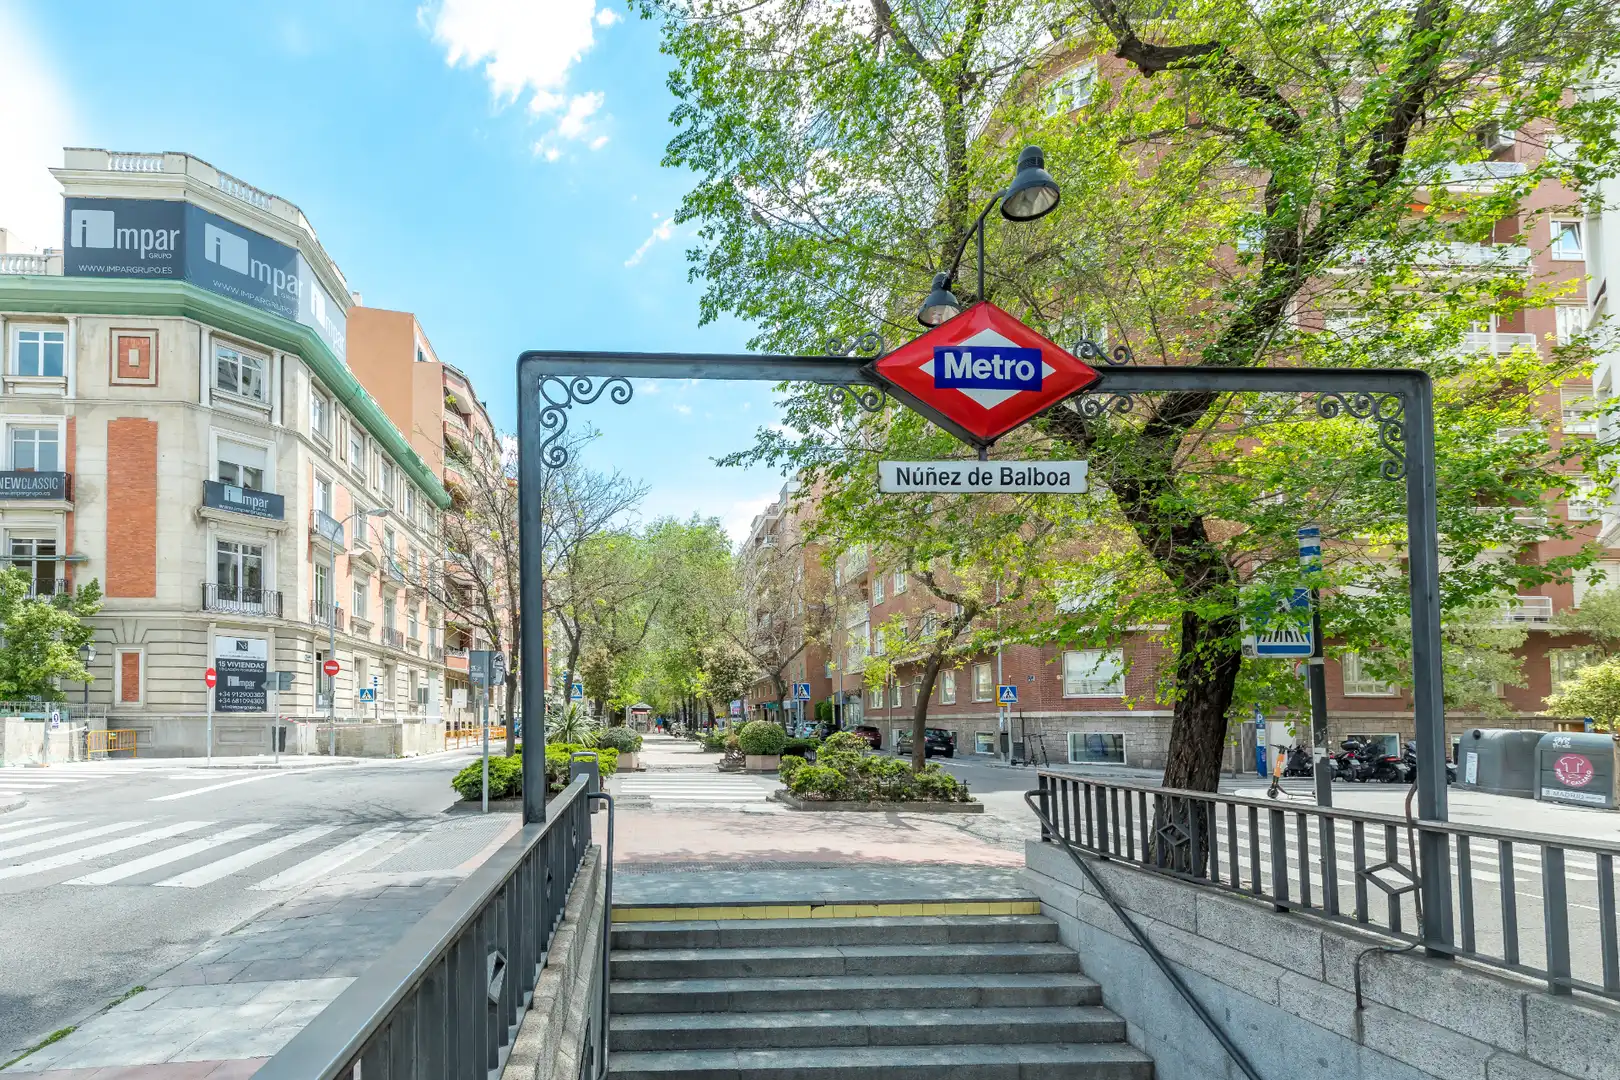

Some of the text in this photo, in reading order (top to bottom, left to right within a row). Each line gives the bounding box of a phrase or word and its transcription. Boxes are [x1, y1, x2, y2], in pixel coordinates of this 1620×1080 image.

[78, 264, 173, 275] WWW.IMPARGRUPO.ES
[944, 352, 1035, 381] Metro
[896, 467, 1070, 486] Núñez de Balboa
[227, 661, 265, 669] VIVIENDAS
[1552, 790, 1585, 799] MADRID
